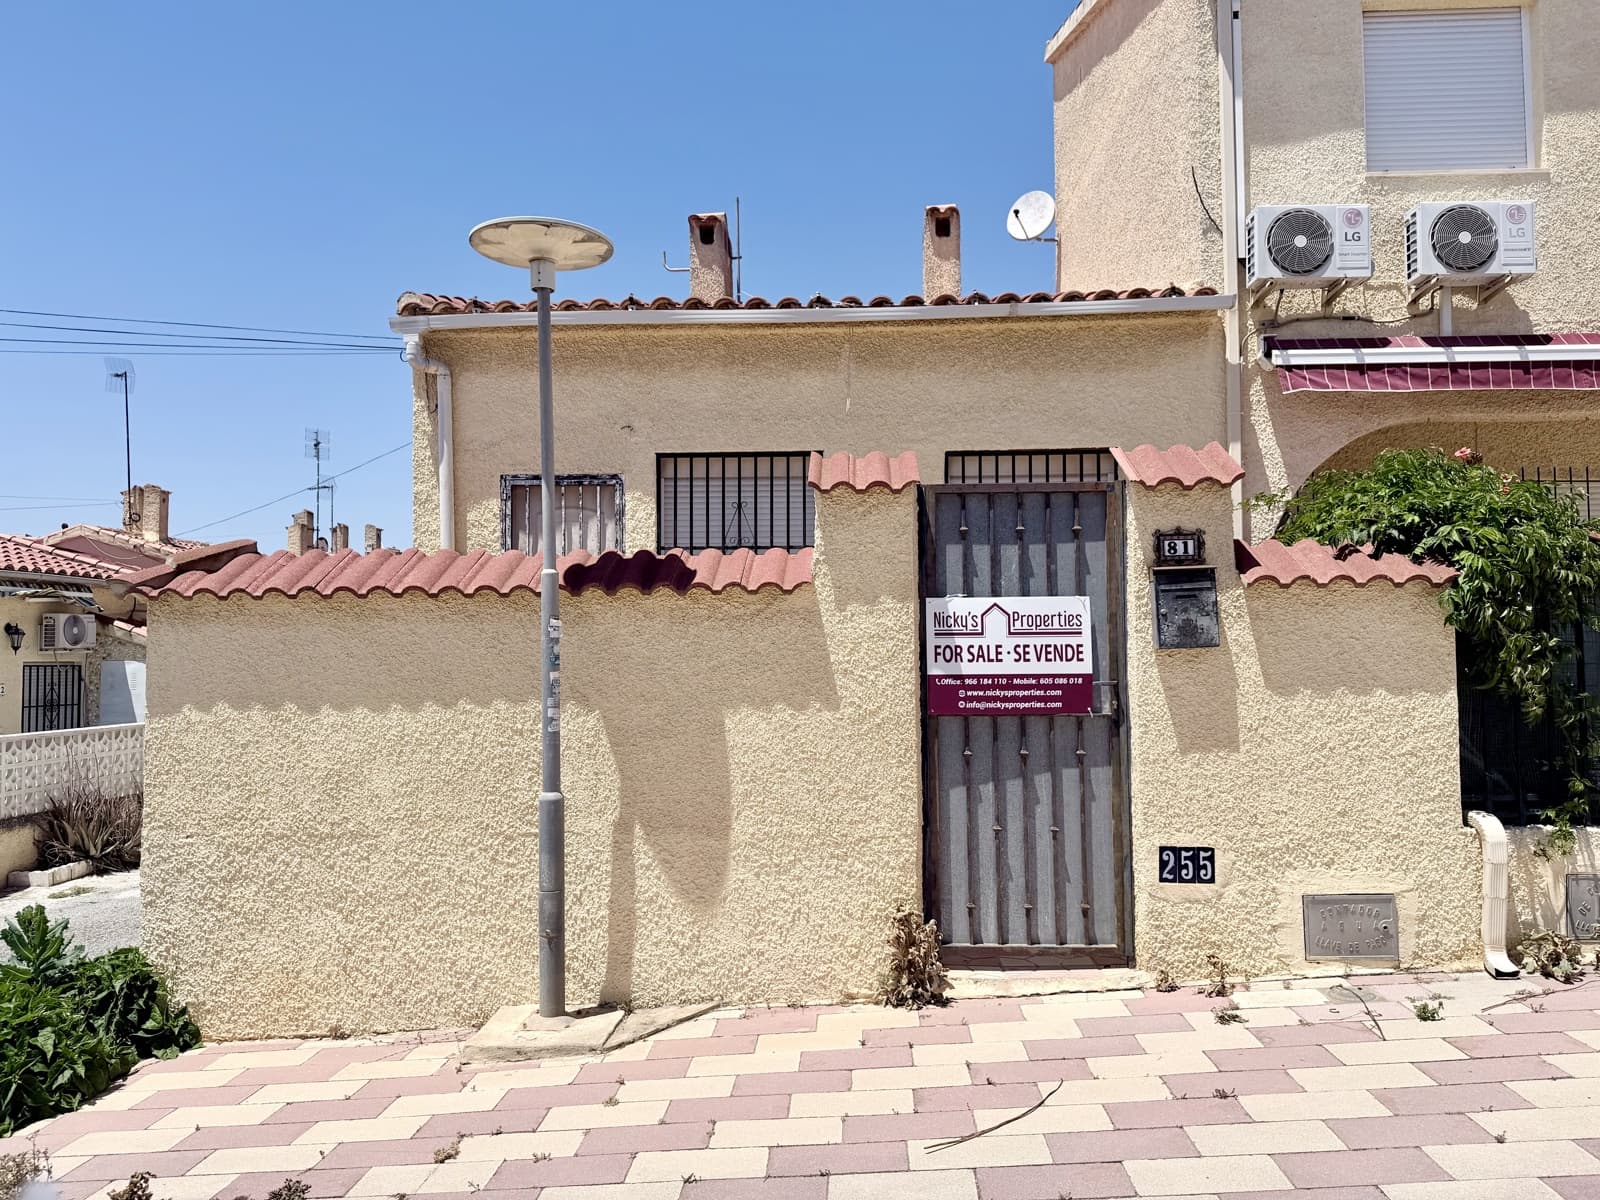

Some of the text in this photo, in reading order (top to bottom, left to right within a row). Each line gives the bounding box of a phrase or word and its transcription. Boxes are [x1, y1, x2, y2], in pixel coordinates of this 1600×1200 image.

[1344, 231, 1361, 242] LG
[1509, 228, 1526, 239] LG
[1167, 541, 1190, 555] 81
[933, 610, 1083, 632] Nicky's Properties
[933, 645, 964, 663] FOR
[967, 644, 1003, 663] SALE
[1013, 644, 1031, 663] SE
[1033, 643, 1085, 662] VENDE
[940, 678, 963, 686] Office:
[964, 678, 978, 686] 966
[979, 678, 992, 686] 184
[994, 678, 1007, 686] 110
[1039, 677, 1053, 685] 605
[1069, 677, 1083, 685] 018
[966, 688, 1062, 698] www.nickysproperties.com
[966, 700, 1062, 710] info@nickysproperties.com
[1162, 850, 1212, 880] 255
